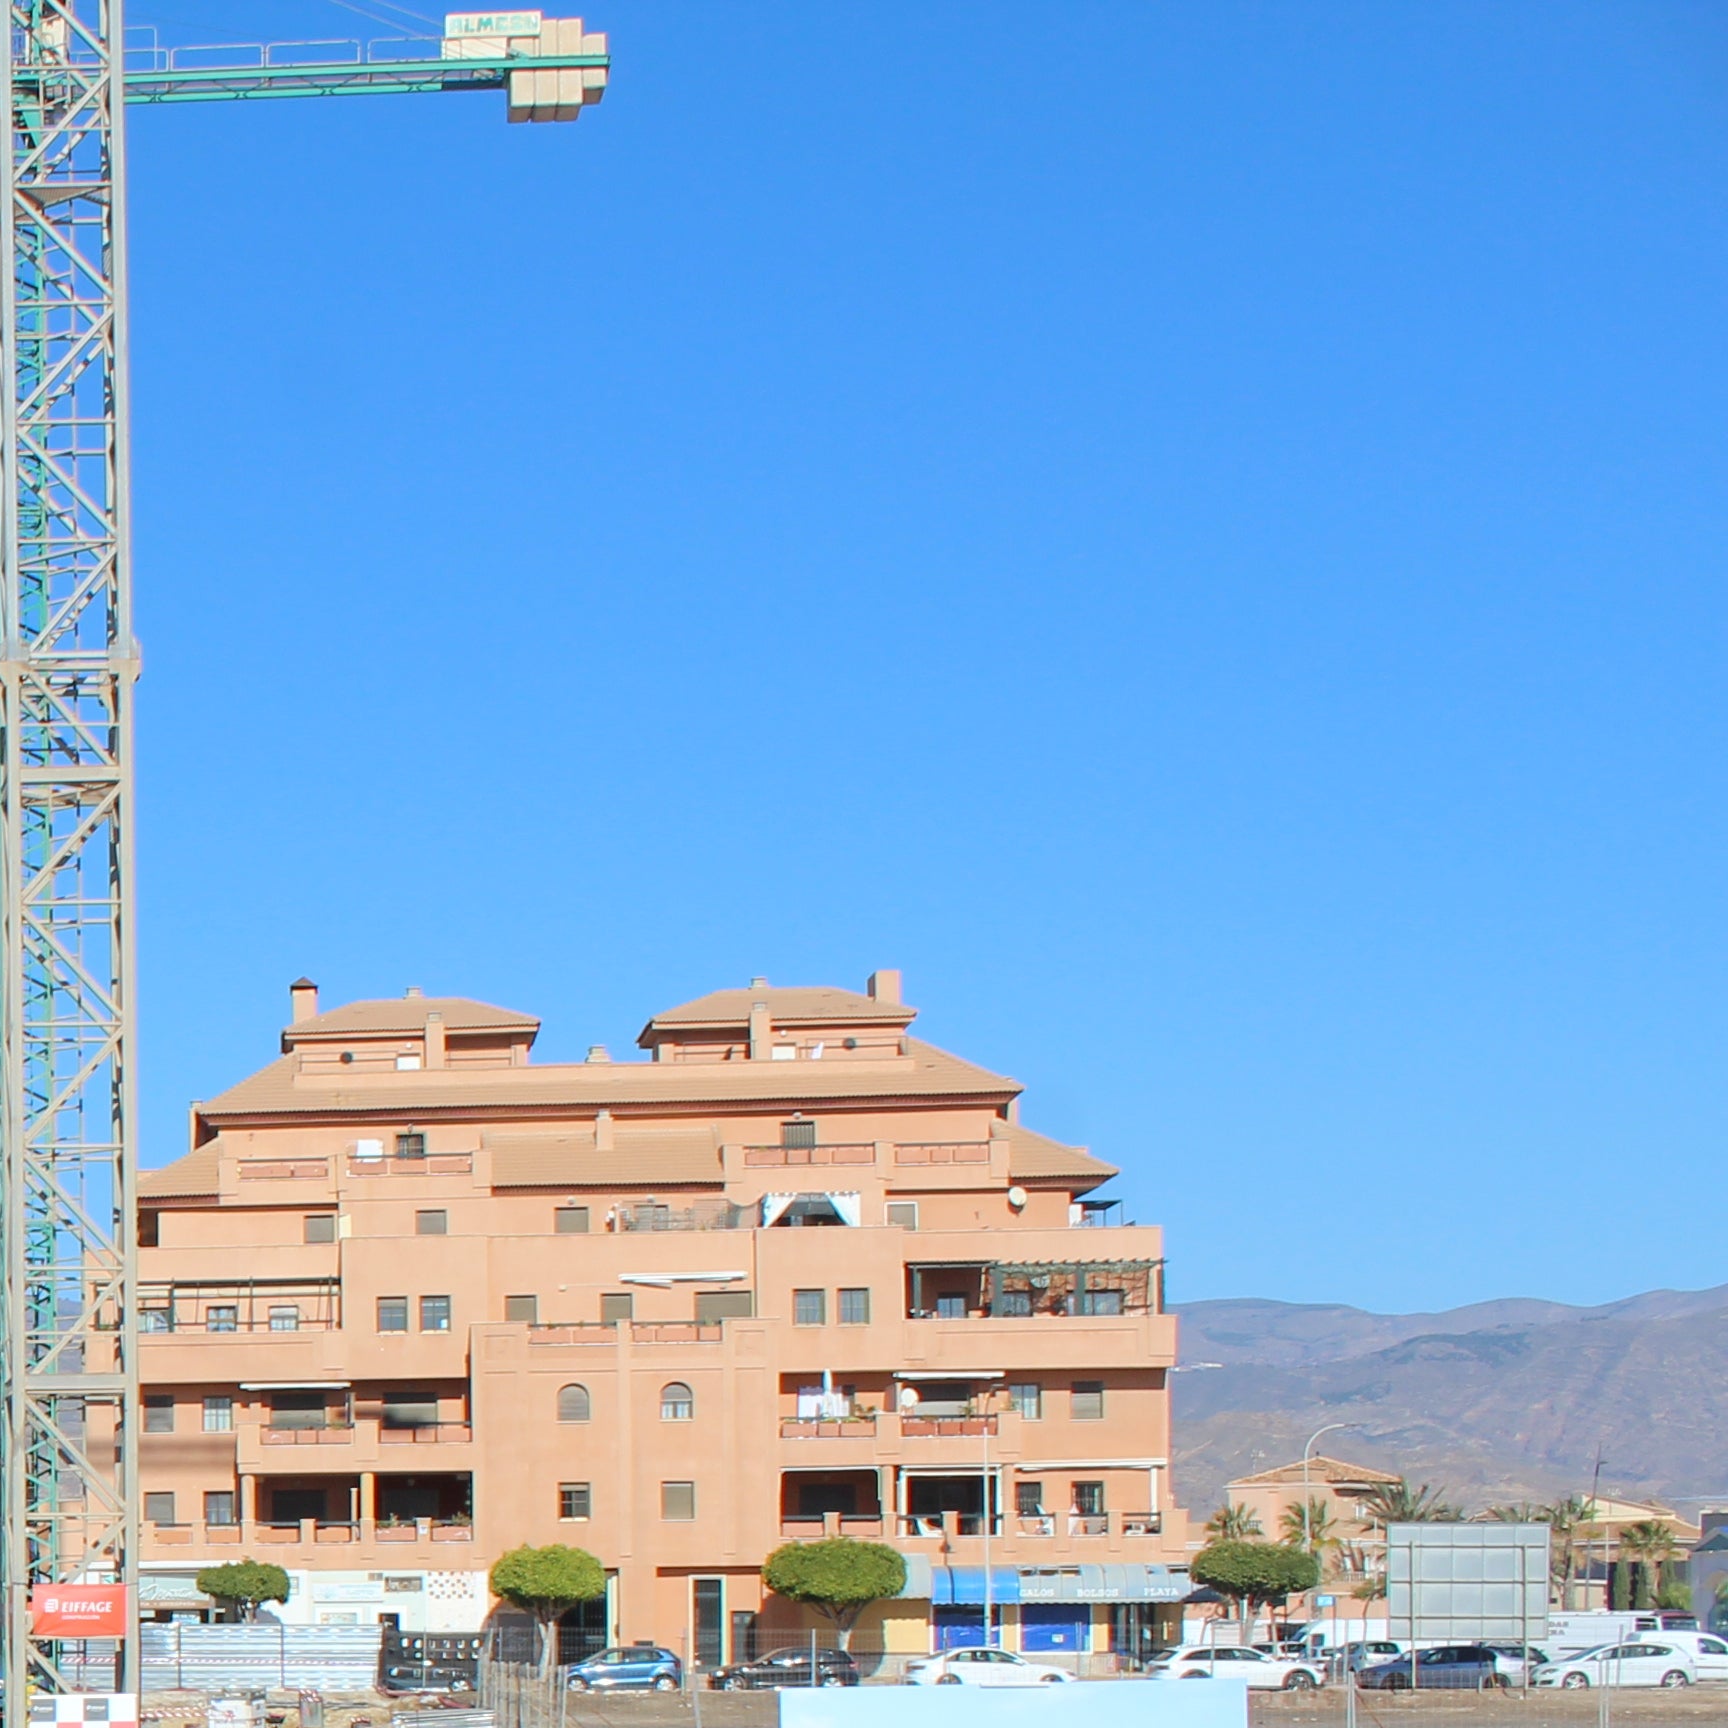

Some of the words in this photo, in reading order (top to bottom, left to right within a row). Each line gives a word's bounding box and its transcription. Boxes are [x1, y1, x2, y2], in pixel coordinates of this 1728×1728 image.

[1076, 1588, 1119, 1597] BOLSOS
[1144, 1587, 1179, 1596] PLAYA
[61, 1601, 113, 1613] EIFFAGE
